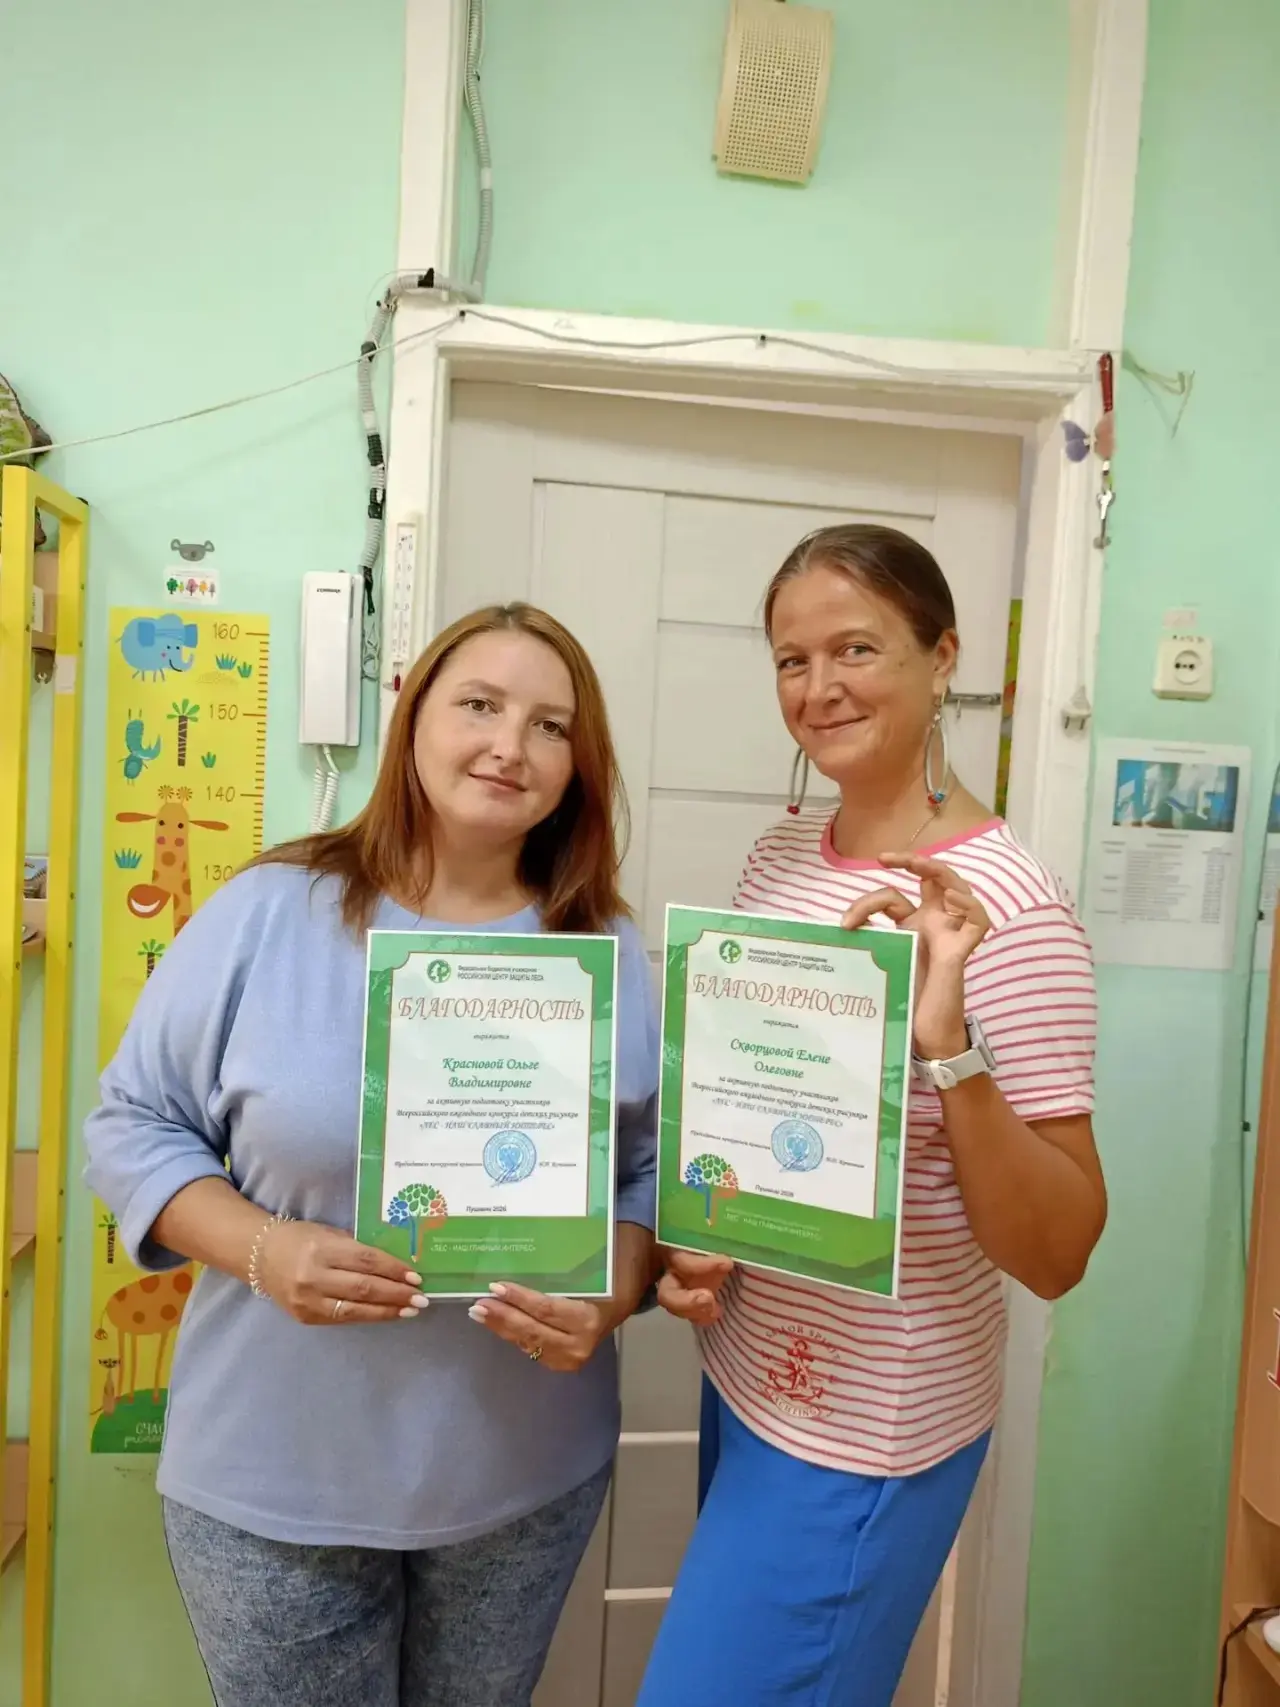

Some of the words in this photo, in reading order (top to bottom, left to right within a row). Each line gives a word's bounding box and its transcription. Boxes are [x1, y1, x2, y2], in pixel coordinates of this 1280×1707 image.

[213, 623, 240, 640] 160
[209, 704, 238, 721] 150
[206, 785, 236, 802] 140
[204, 864, 234, 882] 130
[692, 974, 877, 1019] БЛАГОДАРНОСТЬ
[398, 996, 585, 1022] БЛАГОДАРНОСТЬ
[730, 1038, 794, 1058] Скворцовой
[796, 1049, 831, 1065] Елене
[442, 1057, 504, 1073] Красновой
[506, 1058, 540, 1070] Ольге
[754, 1060, 804, 1079] Олеговне
[448, 1075, 532, 1093] Владимировне
